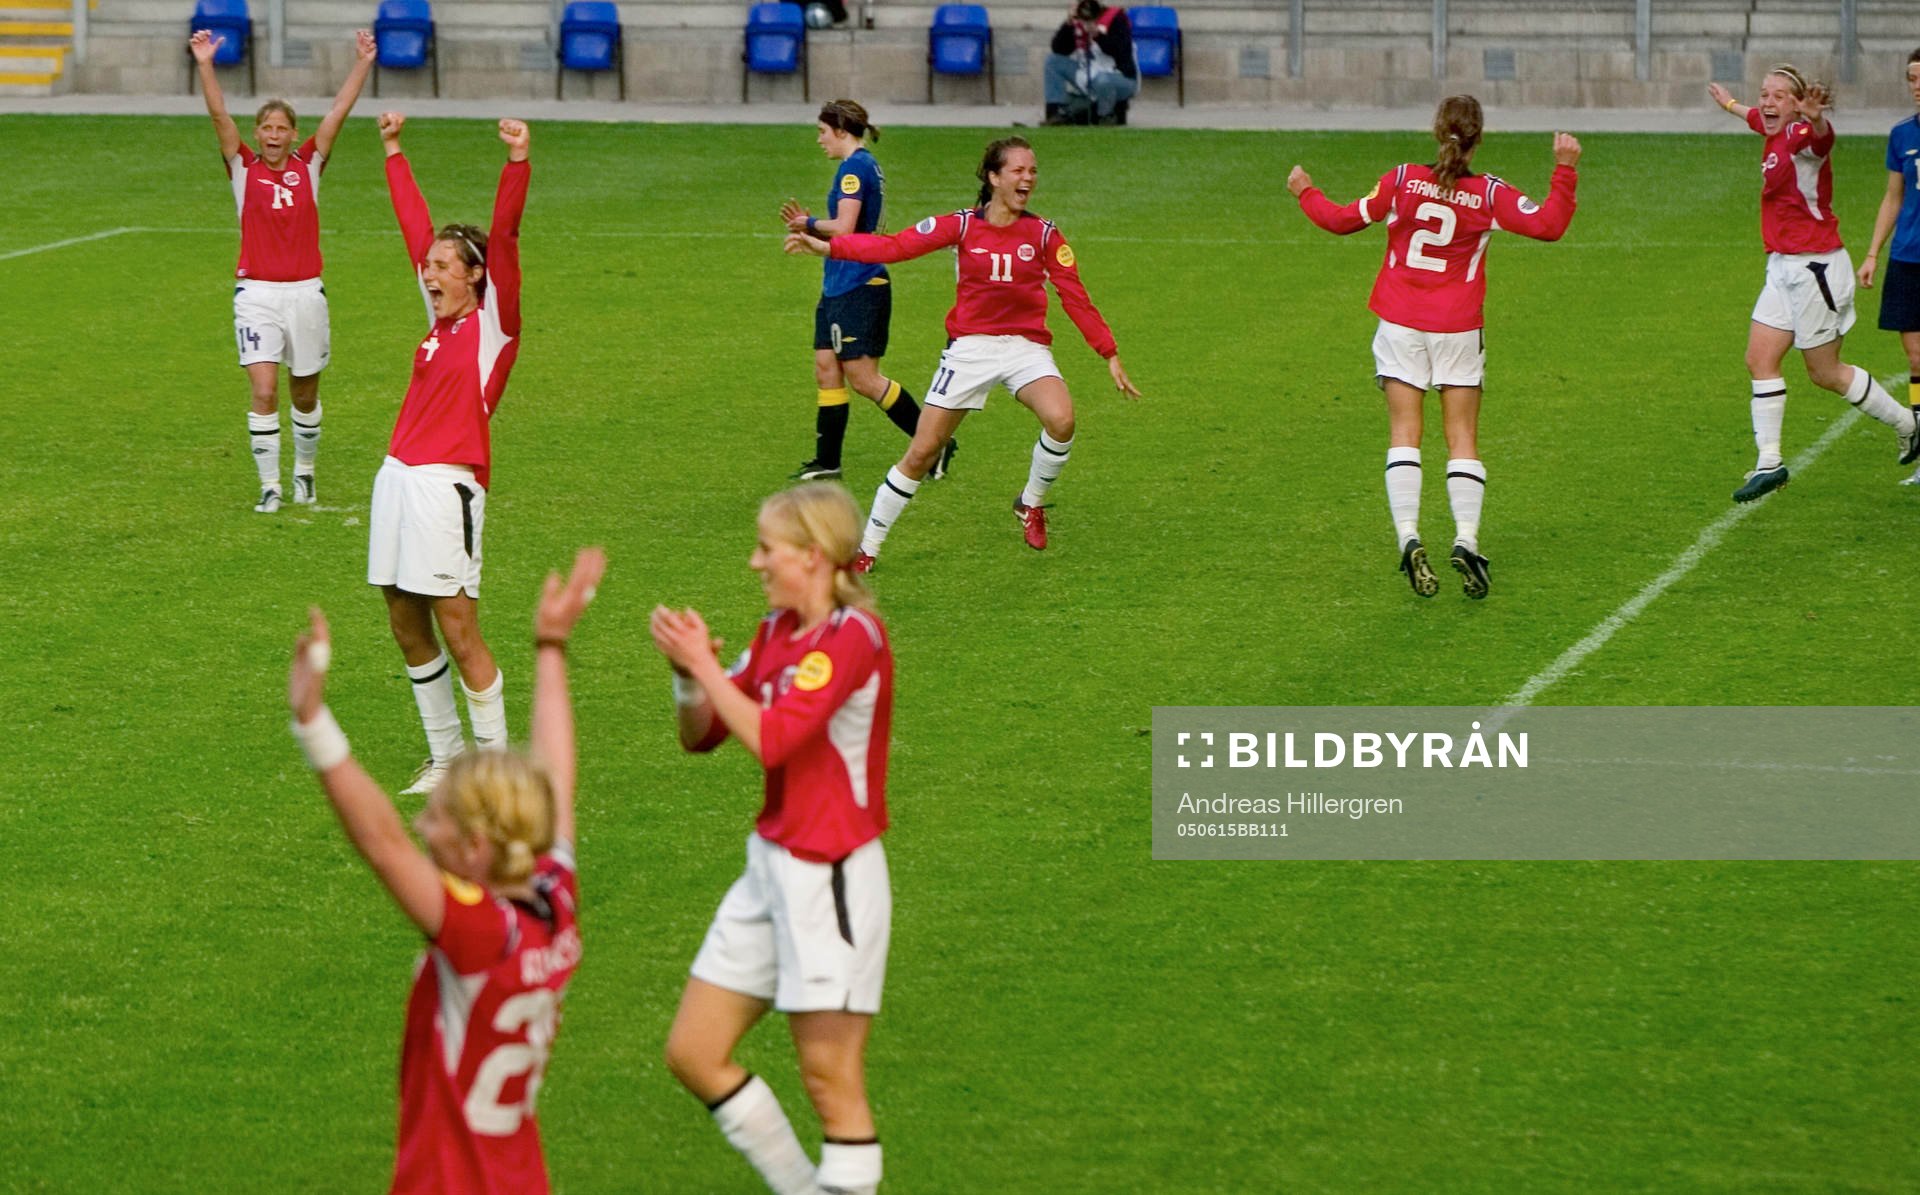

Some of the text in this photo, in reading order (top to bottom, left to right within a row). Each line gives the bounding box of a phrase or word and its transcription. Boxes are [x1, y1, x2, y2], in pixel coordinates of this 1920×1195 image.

[271, 184, 294, 209] 14
[1406, 202, 1457, 272] 2
[989, 253, 1013, 282] 11
[240, 327, 261, 353] 14
[932, 367, 955, 396] 11
